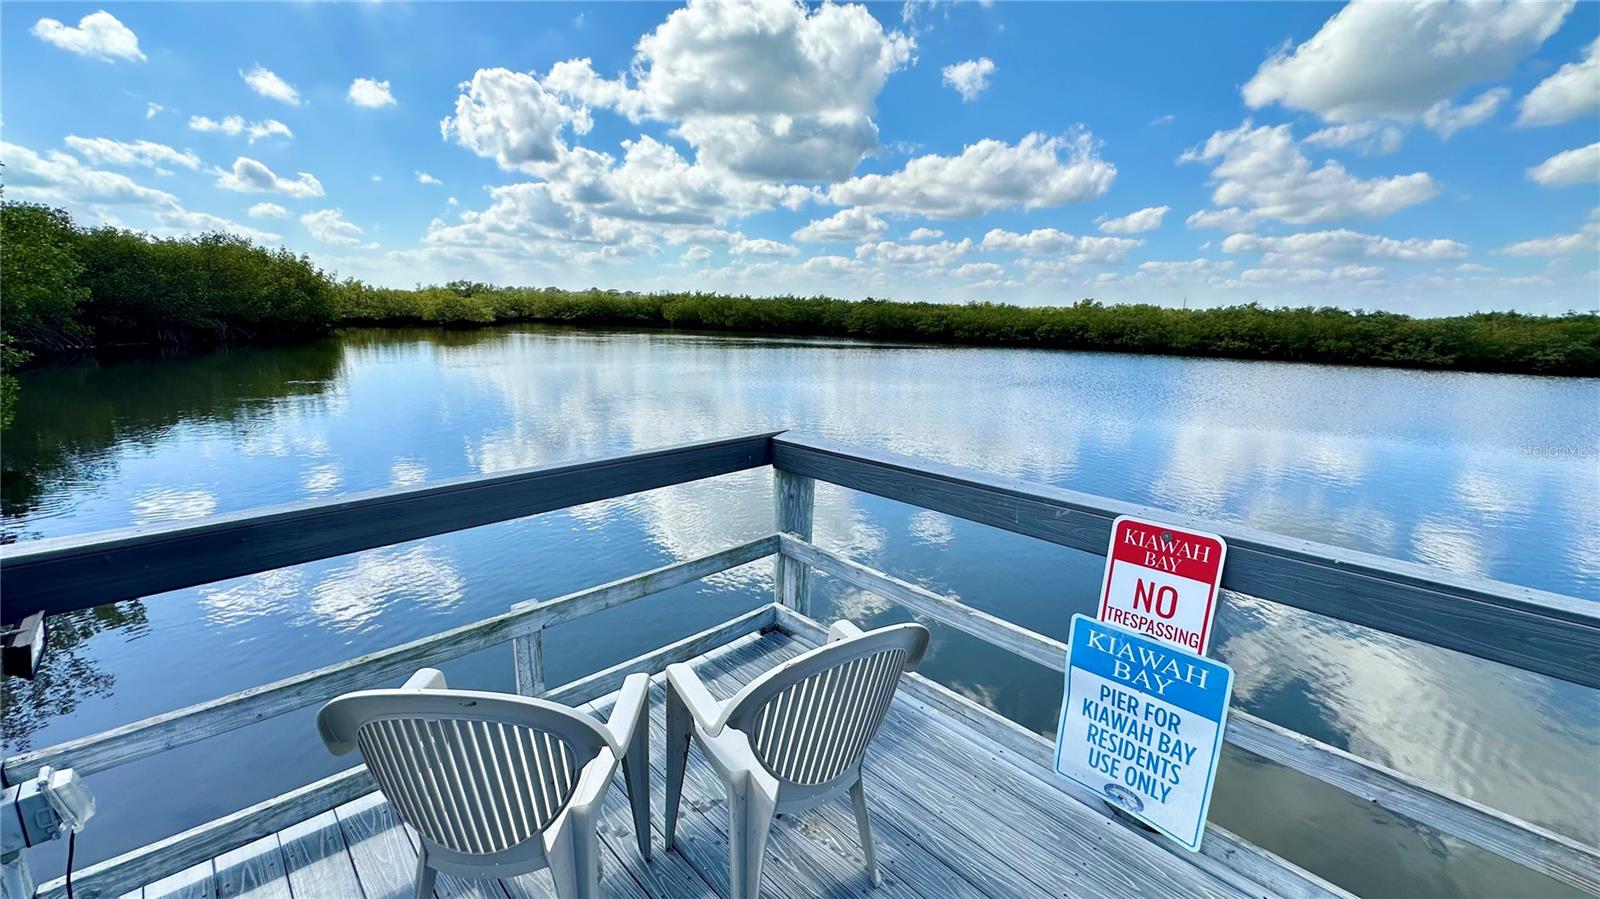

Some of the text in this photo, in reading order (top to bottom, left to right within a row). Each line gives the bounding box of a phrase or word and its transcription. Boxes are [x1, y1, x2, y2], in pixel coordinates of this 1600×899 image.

[1124, 528, 1211, 563] KIAWAH
[1144, 551, 1181, 572] BAY
[1132, 578, 1178, 619] NO
[1108, 606, 1199, 648] TRESPASSING
[1088, 629, 1210, 689] KIAWAH
[1112, 660, 1174, 695] BAY
[1082, 698, 1197, 766] KIAWAH BAY
[1100, 685, 1181, 735] PIER FOR
[1086, 723, 1181, 785] RESIDENTS
[1088, 747, 1121, 779] USE
[1124, 766, 1172, 804] ONLY
